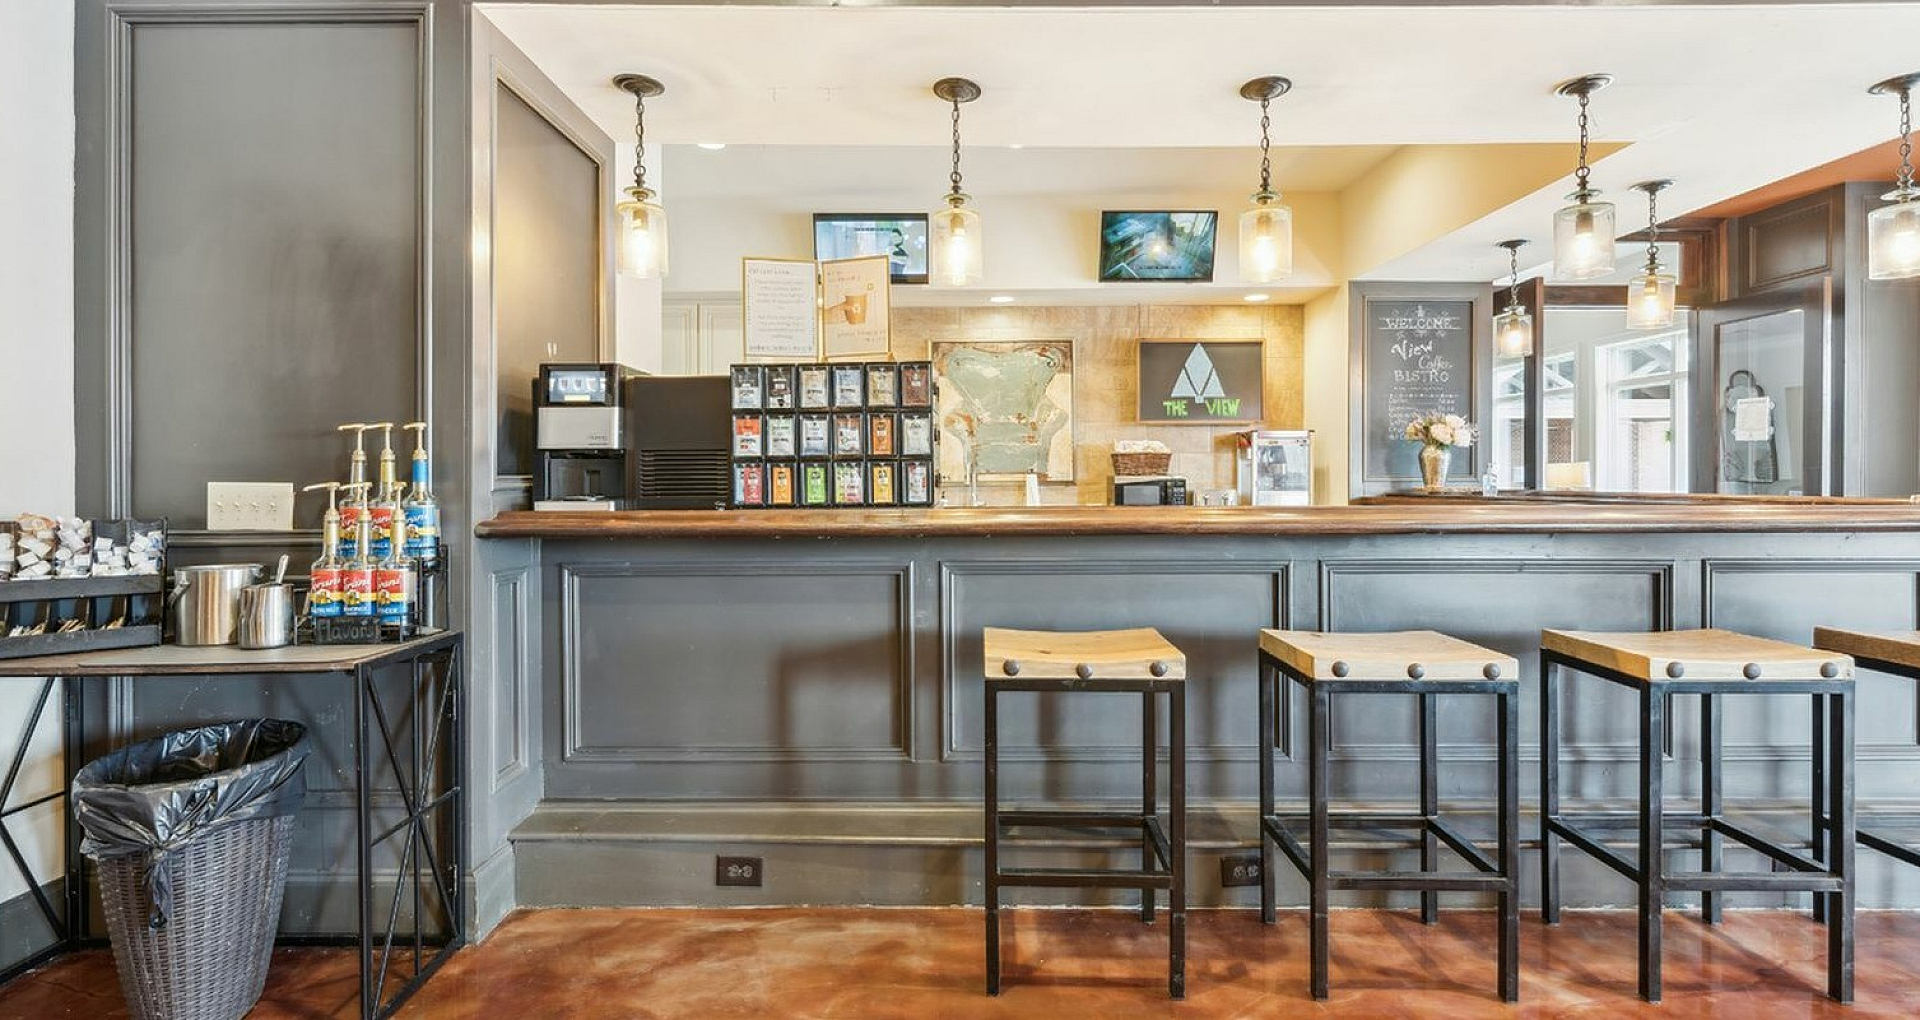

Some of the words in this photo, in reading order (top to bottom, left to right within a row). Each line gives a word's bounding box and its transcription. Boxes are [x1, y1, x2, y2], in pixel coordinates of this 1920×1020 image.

[1385, 318, 1452, 330] WELCOME
[1390, 339, 1433, 361] View
[1393, 369, 1449, 382] BISTRO
[1162, 398, 1189, 417] THE
[1204, 399, 1242, 418] VIEW
